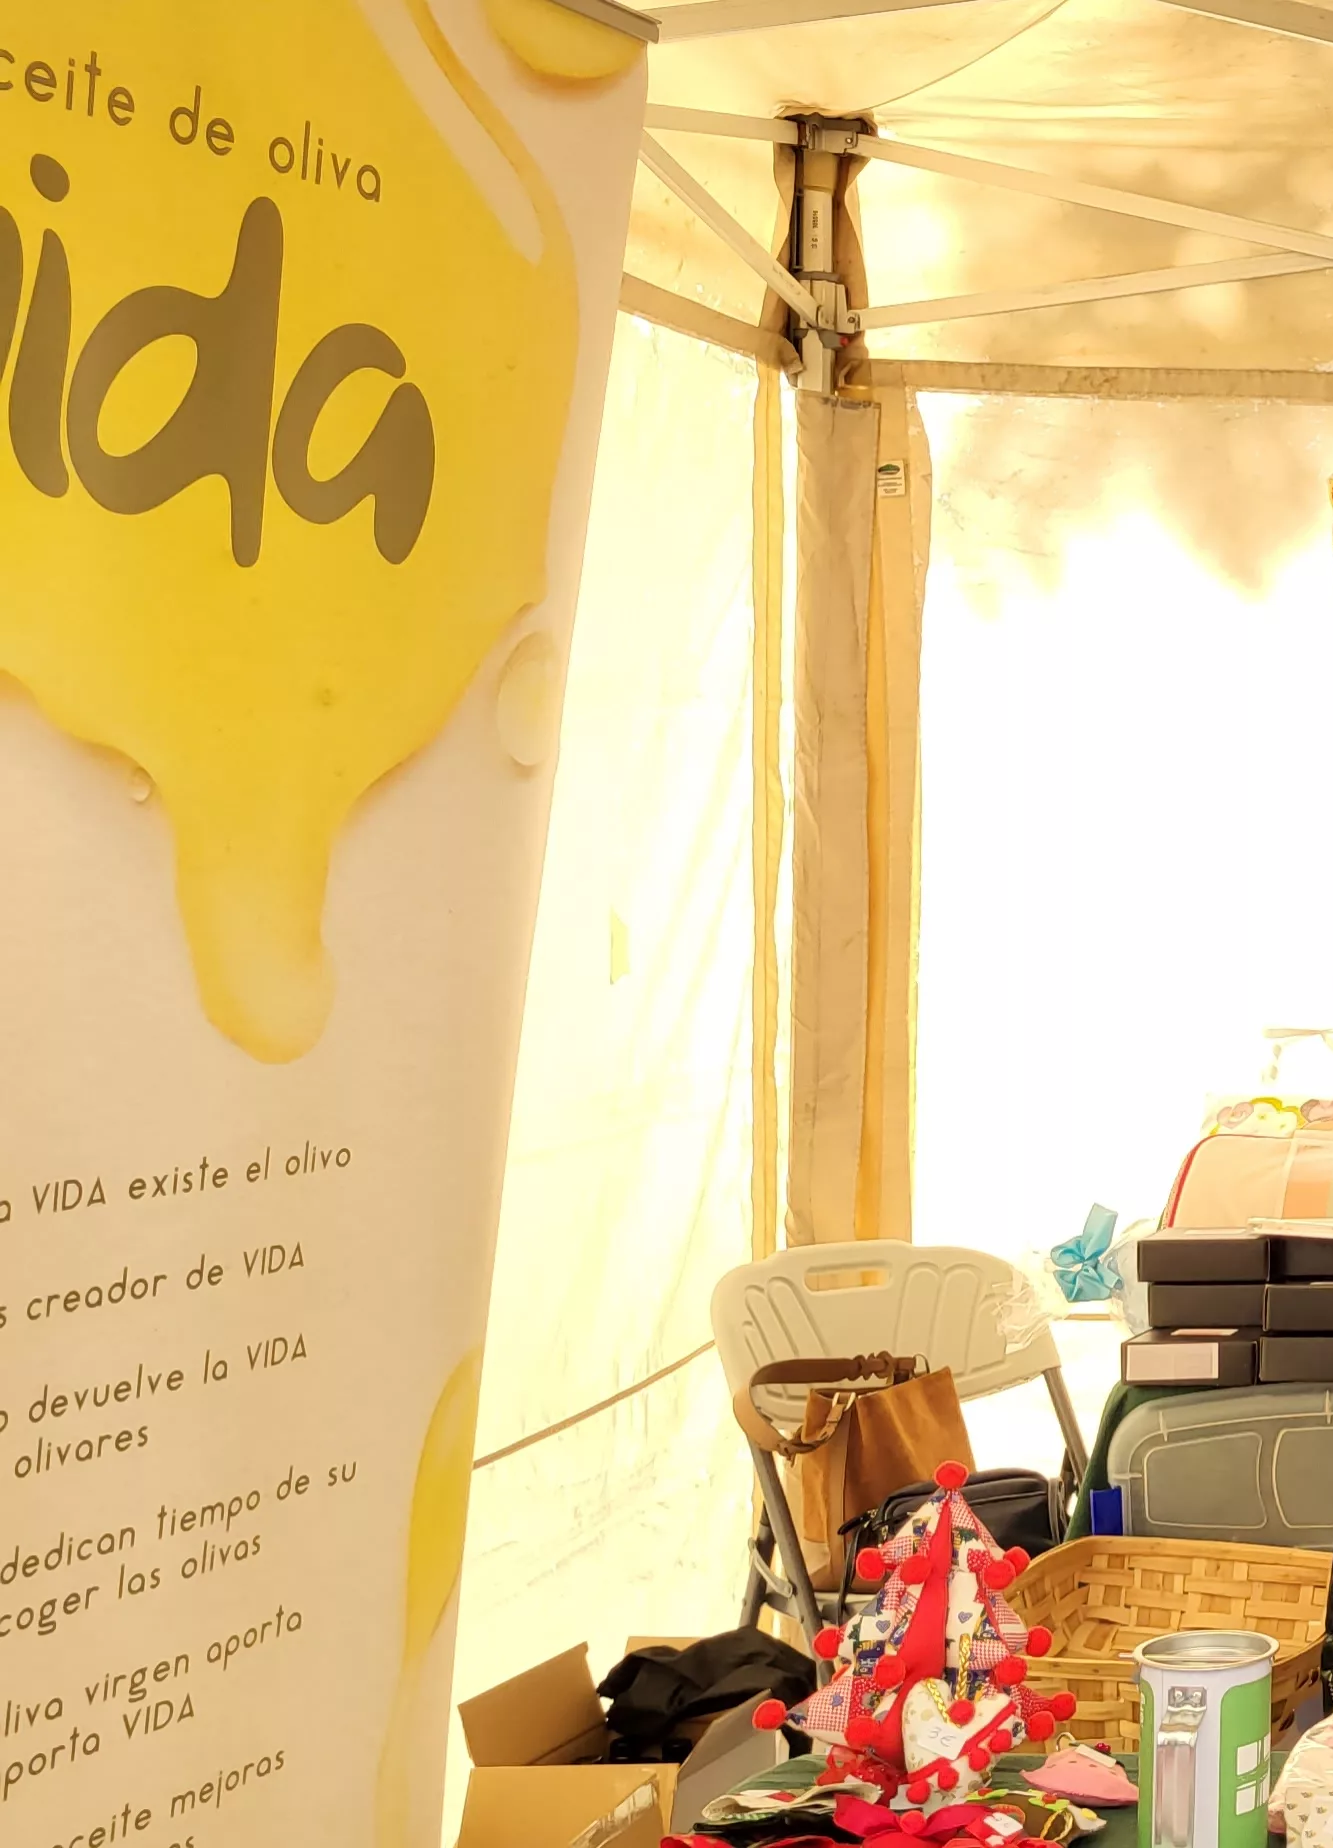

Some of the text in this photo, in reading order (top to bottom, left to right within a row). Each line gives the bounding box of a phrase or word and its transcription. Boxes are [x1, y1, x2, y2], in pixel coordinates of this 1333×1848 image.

[169, 85, 235, 156] de
[268, 120, 382, 203] oliva
[0, 154, 435, 568] ida
[32, 1177, 106, 1214] VIDA
[128, 1156, 229, 1200] existe
[246, 1147, 271, 1183] el
[285, 1140, 352, 1177] olivo
[27, 1266, 168, 1321] creador
[186, 1253, 224, 1291] de
[243, 1242, 305, 1278] VIDA
[29, 1364, 185, 1424] devuelve
[203, 1350, 228, 1385] la
[247, 1333, 308, 1371] VIDA
[14, 1425, 149, 1479] olivares
[0, 1461, 358, 1585] dedican tiempo de su
[118, 1563, 161, 1599] las
[181, 1534, 262, 1579] olivas
[4, 1604, 303, 1737] liva virgen aporta
[3, 1692, 195, 1801] porta VIDA
[51, 1750, 285, 1848] ceite mejoras
